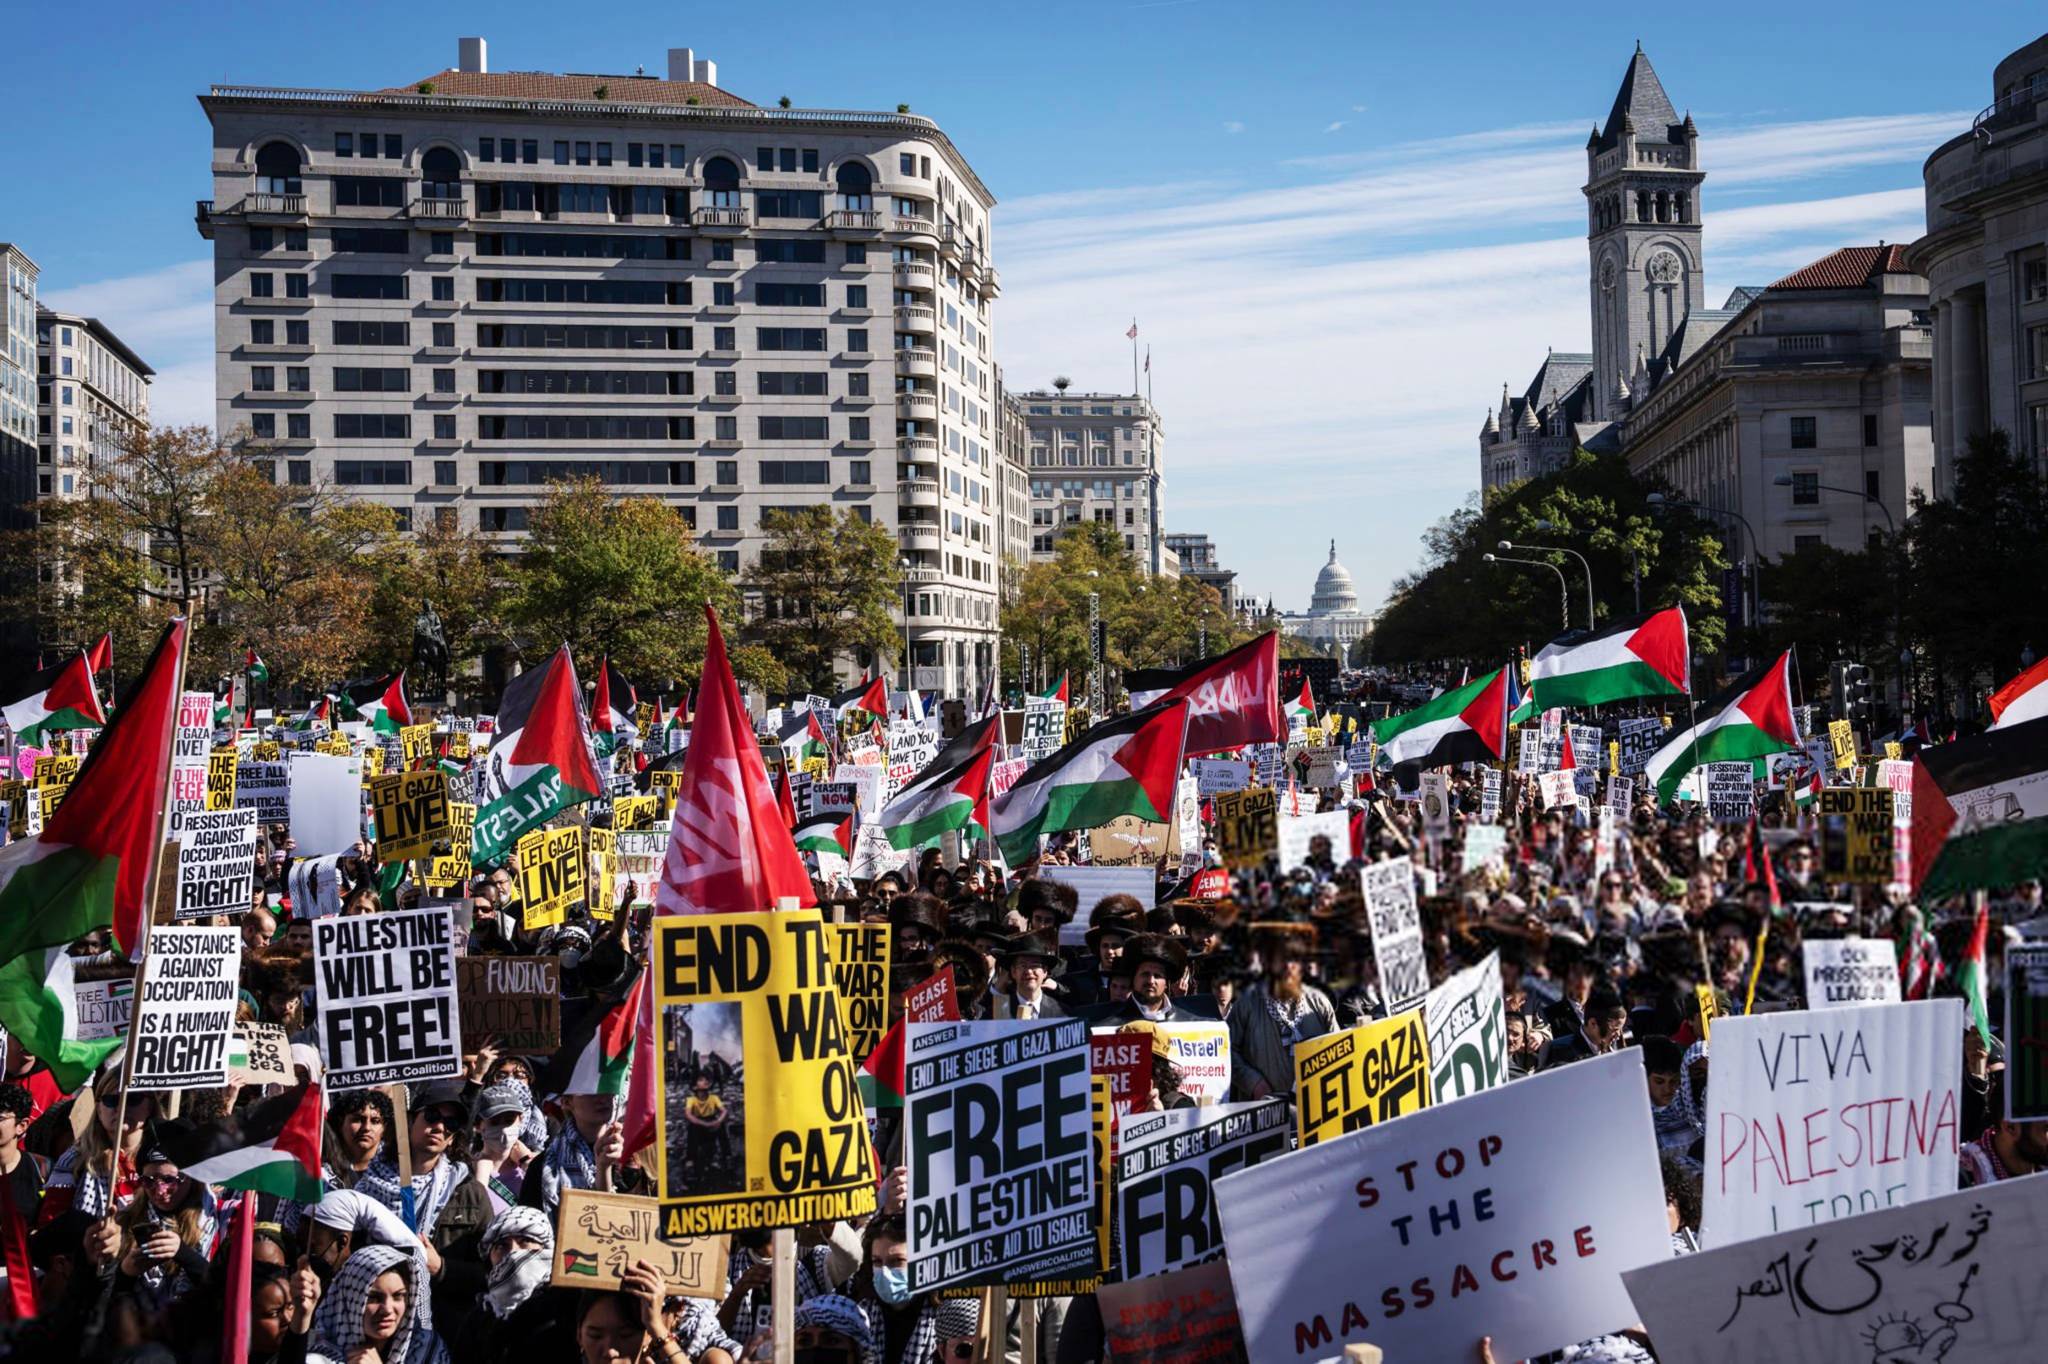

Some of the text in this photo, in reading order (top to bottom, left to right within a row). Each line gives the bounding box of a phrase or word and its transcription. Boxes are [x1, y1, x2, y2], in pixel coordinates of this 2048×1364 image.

[808, 695, 828, 708] FREE
[183, 728, 210, 739] GAZA
[1024, 711, 1065, 737] FREE
[1572, 728, 1600, 739] FREE ALL
[891, 736, 916, 751] LAND
[918, 731, 935, 746] YOU
[1023, 735, 1061, 750] PALESTINE
[210, 756, 234, 774] THE
[889, 749, 926, 765] HAVE TO
[34, 763, 55, 778] LET
[186, 768, 205, 781] THE
[236, 766, 286, 780] FREE ALL
[889, 764, 914, 779] KILL
[1709, 763, 1751, 773] RESISTANCE
[1715, 773, 1745, 782] AGAINST
[373, 785, 402, 808] LET
[405, 772, 445, 800] GAZA
[652, 773, 674, 786] END
[1614, 778, 1630, 789] END
[1709, 782, 1751, 791] OCCUPATION
[213, 793, 232, 808] ON
[237, 797, 288, 808] POLITICAL
[822, 794, 848, 805] NOW
[1243, 791, 1275, 812] GAZA
[1614, 790, 1627, 800] U.S.
[1710, 791, 1751, 801] IS A HUMAN
[1821, 790, 1891, 813] END THE
[177, 800, 206, 812] GAZA
[451, 805, 475, 826] THE
[633, 801, 656, 823] GAZA
[185, 811, 255, 831] RESISTANCE
[375, 790, 449, 845] LIVE!
[194, 828, 245, 846] AGAINST
[591, 828, 607, 852] END
[181, 843, 255, 863] OCCUPATION
[454, 844, 471, 863] ON
[520, 829, 580, 871] LET GAZA
[1095, 853, 1137, 867] Support
[183, 860, 252, 881] IS A HUMAN
[438, 860, 469, 879] GAZA
[522, 848, 581, 910] LIVE!
[180, 875, 251, 909] RIGHT!
[526, 907, 540, 922] STOP
[149, 934, 236, 955] RESISTANCE
[318, 912, 450, 957] PALESTINE
[837, 928, 887, 964] THE
[158, 957, 224, 978] AGAINST
[662, 923, 771, 997] END
[321, 949, 452, 1001] WILL BE
[487, 958, 557, 995] FUNDING
[76, 988, 104, 1002] FREE
[143, 980, 234, 1002] OCCUPATION
[911, 976, 948, 1012] CEASE
[140, 1011, 230, 1034] IS A HUMAN
[850, 1000, 884, 1030] ON
[248, 1030, 285, 1041] river
[325, 996, 453, 1070] FREE!
[914, 1027, 956, 1050] ANSWER
[134, 1033, 226, 1074] RIGHT!
[249, 1050, 280, 1062] the
[253, 1040, 279, 1053] to
[911, 1021, 1087, 1091] END THE SIEGE ON GAZA NOW!
[249, 1058, 286, 1074] sea
[1302, 1039, 1354, 1078] ANSWER
[1757, 1029, 1872, 1093] VIVA
[139, 1077, 156, 1085] Party
[156, 1077, 166, 1085] for
[166, 1076, 190, 1084] Socialism
[198, 1074, 224, 1083] Liberation
[329, 1062, 455, 1087] A.N.S.W.E.R. Coalition
[1301, 1020, 1424, 1132] LET GAZA
[911, 1052, 1088, 1201] FREE
[1124, 1117, 1164, 1142] ANSWER
[1124, 1105, 1286, 1179] END THE SIEGE ON GAZA NOW!
[1720, 1088, 1959, 1196] PALESTINA
[769, 1122, 873, 1193] GAZA
[1355, 1133, 1504, 1209] STOP
[666, 1187, 877, 1237] ANSWERCOALITION.ORG
[913, 1154, 1090, 1253] PALESTINE!
[1124, 1131, 1284, 1280] FRE
[1390, 1186, 1497, 1247] THE
[915, 1210, 1092, 1288] END ALL U.S. AID TO ISRAEL
[1003, 1245, 1094, 1282] @ANSWERCOALITION
[1293, 1224, 1597, 1356] MASSACRE
